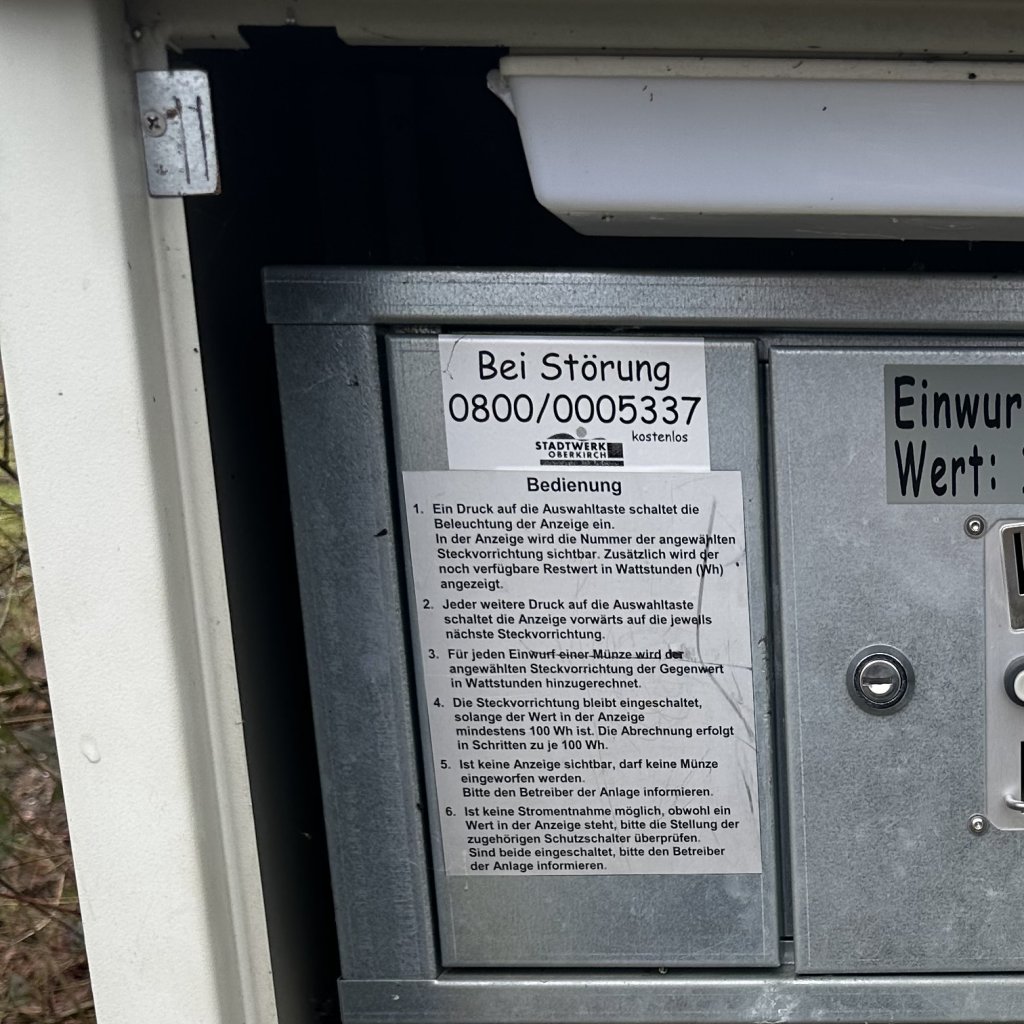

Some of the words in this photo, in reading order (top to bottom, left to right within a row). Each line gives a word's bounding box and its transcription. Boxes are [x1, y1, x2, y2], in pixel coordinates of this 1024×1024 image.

[478, 350, 526, 380] Bei
[541, 352, 670, 391] Störung
[449, 393, 701, 425] 0800/0005337
[632, 430, 688, 442] kostenlos
[536, 440, 606, 450] STADTWERK
[548, 450, 608, 460] OBERKIRCH
[894, 440, 996, 498] Wert:
[527, 477, 622, 496] Bedienung
[413, 503, 424, 514] 1.
[432, 503, 453, 514] Ein
[456, 503, 494, 514] Druck
[497, 503, 517, 514] auf
[520, 504, 539, 514] die
[542, 504, 626, 514] Auswahltaste
[629, 504, 678, 514] schaltet
[681, 504, 699, 514] die
[434, 518, 513, 532] Beleuchtung
[516, 518, 536, 529] der
[540, 518, 589, 532] Anzeige
[592, 519, 614, 529] ein.
[440, 578, 503, 592] angezeigt.
[422, 598, 434, 610] 2.
[442, 599, 477, 610] Jeder
[480, 599, 525, 610] weitere
[528, 599, 565, 610] Druck
[568, 599, 587, 610] auf
[591, 599, 610, 610] die
[613, 599, 694, 610] Auswahltaste
[446, 628, 494, 639] nächste
[498, 628, 605, 642] Steckvorrichtung.
[450, 678, 462, 688] in
[465, 678, 542, 688] Wattstunden
[546, 678, 641, 690] hinzugerechnet.
[433, 697, 444, 708] 4.
[452, 697, 473, 708] Die
[476, 697, 580, 710] Steckvorrichtung
[583, 698, 617, 708] bleibt
[620, 698, 702, 710] eingeschaltet,
[454, 712, 502, 724] solange
[506, 712, 526, 722] der
[528, 712, 557, 722] Wert
[560, 712, 571, 722] in
[575, 712, 594, 722] der
[598, 712, 645, 724] Anzeige
[456, 726, 526, 736] mindestens
[530, 726, 550, 736] 100
[553, 726, 573, 736] Wh
[576, 726, 594, 736] ist.
[598, 726, 618, 736] Die
[621, 726, 692, 738] Abrechnung
[696, 726, 734, 738] erfolgt
[457, 740, 469, 750] in
[472, 740, 527, 750] Schritten
[530, 742, 544, 750] zu
[547, 740, 558, 752] je
[562, 740, 582, 750] 100
[585, 740, 608, 750] Wh.
[440, 759, 451, 770] 5.
[459, 759, 475, 770] Ist
[478, 759, 510, 769] keine
[514, 759, 561, 772] Anzeige
[564, 759, 616, 770] sichtbar,
[619, 759, 642, 769] darf
[646, 759, 677, 769] keine
[680, 758, 718, 769] Münze
[461, 773, 535, 786] eingeworfen
[538, 773, 584, 783] werden.
[462, 787, 490, 797] Bitte
[494, 787, 516, 797] den
[519, 787, 574, 797] Betreiber
[577, 787, 596, 797] der
[600, 787, 640, 799] Anlage
[644, 786, 713, 797] informieren.
[445, 806, 456, 816] 6.
[464, 806, 480, 816] Ist
[482, 806, 514, 816] keine
[518, 806, 611, 816] Stromentnahme
[615, 806, 664, 818] möglich,
[668, 806, 710, 816] obwohl
[714, 806, 731, 815] ein
[465, 820, 494, 830] Wert
[497, 820, 508, 830] in
[512, 820, 531, 830] der
[534, 820, 581, 832] Anzeige
[584, 820, 617, 831] steht,
[620, 820, 646, 830] bitte
[649, 820, 667, 829] die
[670, 819, 718, 831] Stellung
[721, 819, 740, 829] der
[467, 834, 541, 846] zugehörigen
[544, 834, 631, 844] Schutzschalter
[634, 833, 700, 845] überprüfen.
[469, 847, 496, 858] Sind
[499, 848, 532, 857] beide
[534, 847, 616, 859] eingeschaltet,
[619, 847, 644, 856] bitte
[648, 846, 669, 856] den
[672, 846, 725, 856] Betreiber
[470, 861, 490, 871] der
[493, 861, 534, 873] Anlage
[537, 861, 608, 870] informieren.
